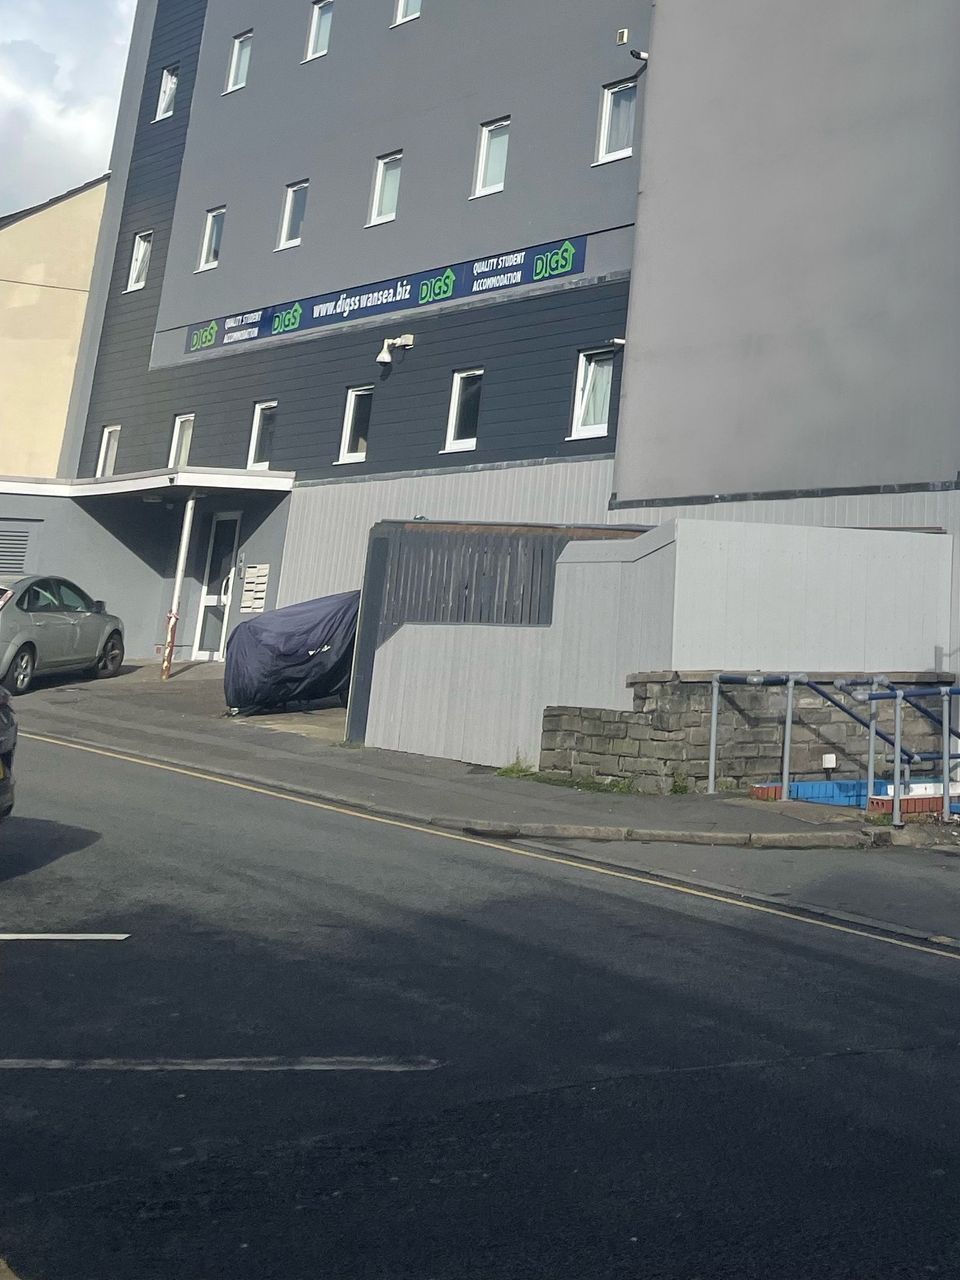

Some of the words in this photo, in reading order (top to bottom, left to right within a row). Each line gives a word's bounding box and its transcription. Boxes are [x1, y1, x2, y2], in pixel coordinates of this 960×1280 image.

[473, 257, 499, 276] QUALITY
[498, 251, 525, 268] STUDENT
[533, 247, 570, 279] DIGS
[419, 274, 451, 303] DIGS
[472, 270, 522, 292] ACCOMMODATION
[313, 281, 411, 318] www.digsswansea.biz
[272, 307, 300, 334] DIGS
[190, 328, 215, 351] DIGS
